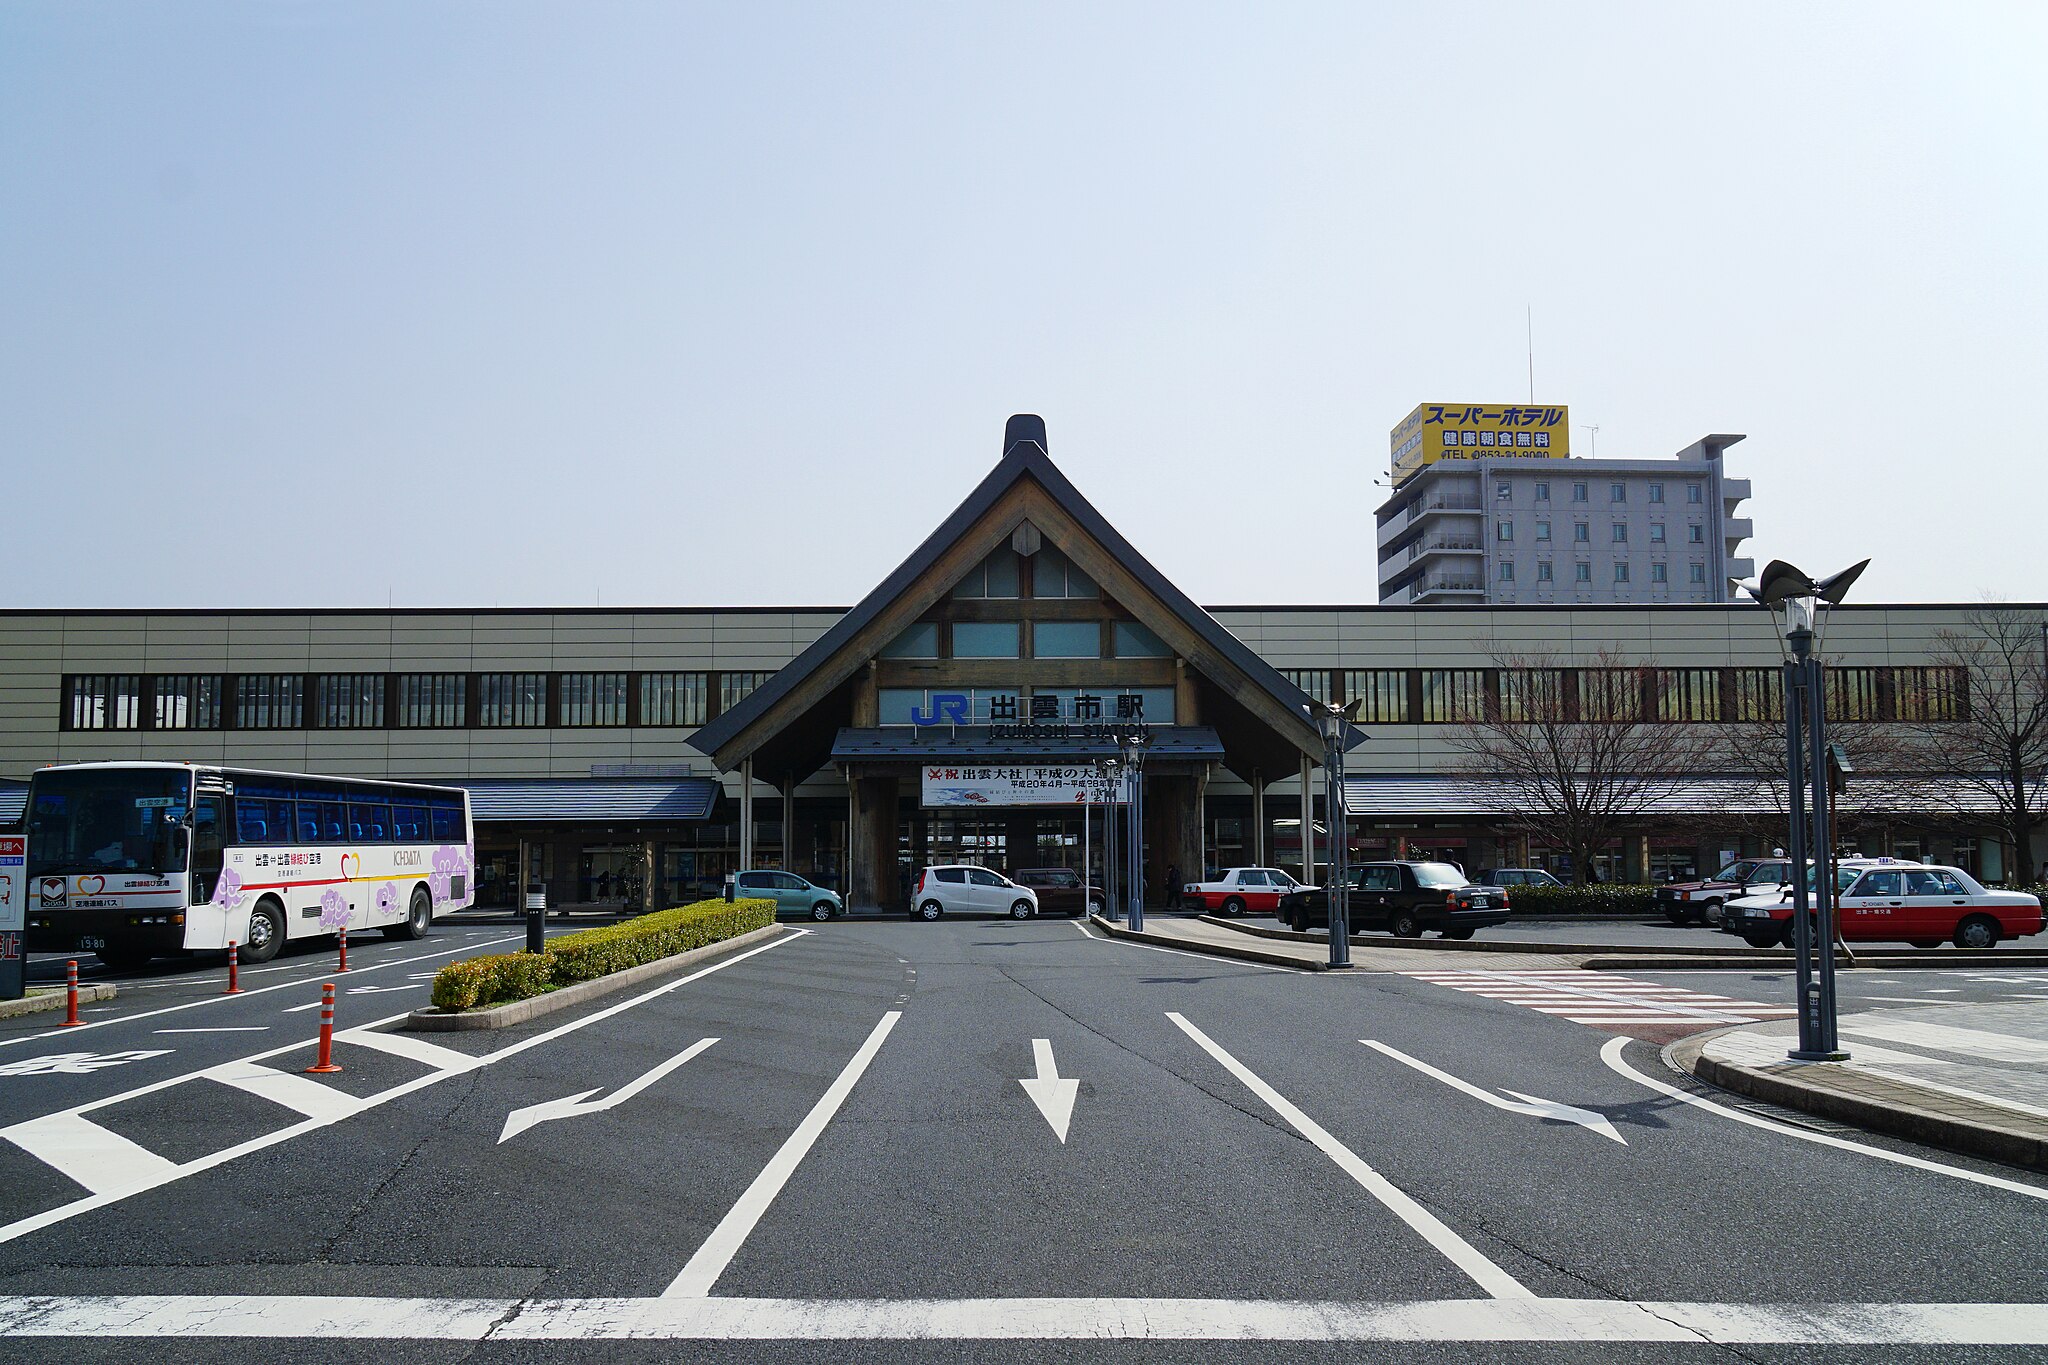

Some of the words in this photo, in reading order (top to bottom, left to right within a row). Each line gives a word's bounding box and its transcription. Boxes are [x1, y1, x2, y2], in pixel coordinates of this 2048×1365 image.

[1424, 406, 1564, 427] スーパーホテル
[1443, 431, 1549, 447] 健康朝食無料
[1446, 449, 1467, 459] TEL
[911, 694, 969, 726] JR
[990, 694, 1144, 720] 出雲市駅
[989, 725, 1069, 739] IZUMOSHI
[1082, 725, 1149, 739] STATION
[255, 854, 269, 867] 出雲
[0, 932, 20, 960] 止
[1809, 997, 1820, 1028] 出雲市
